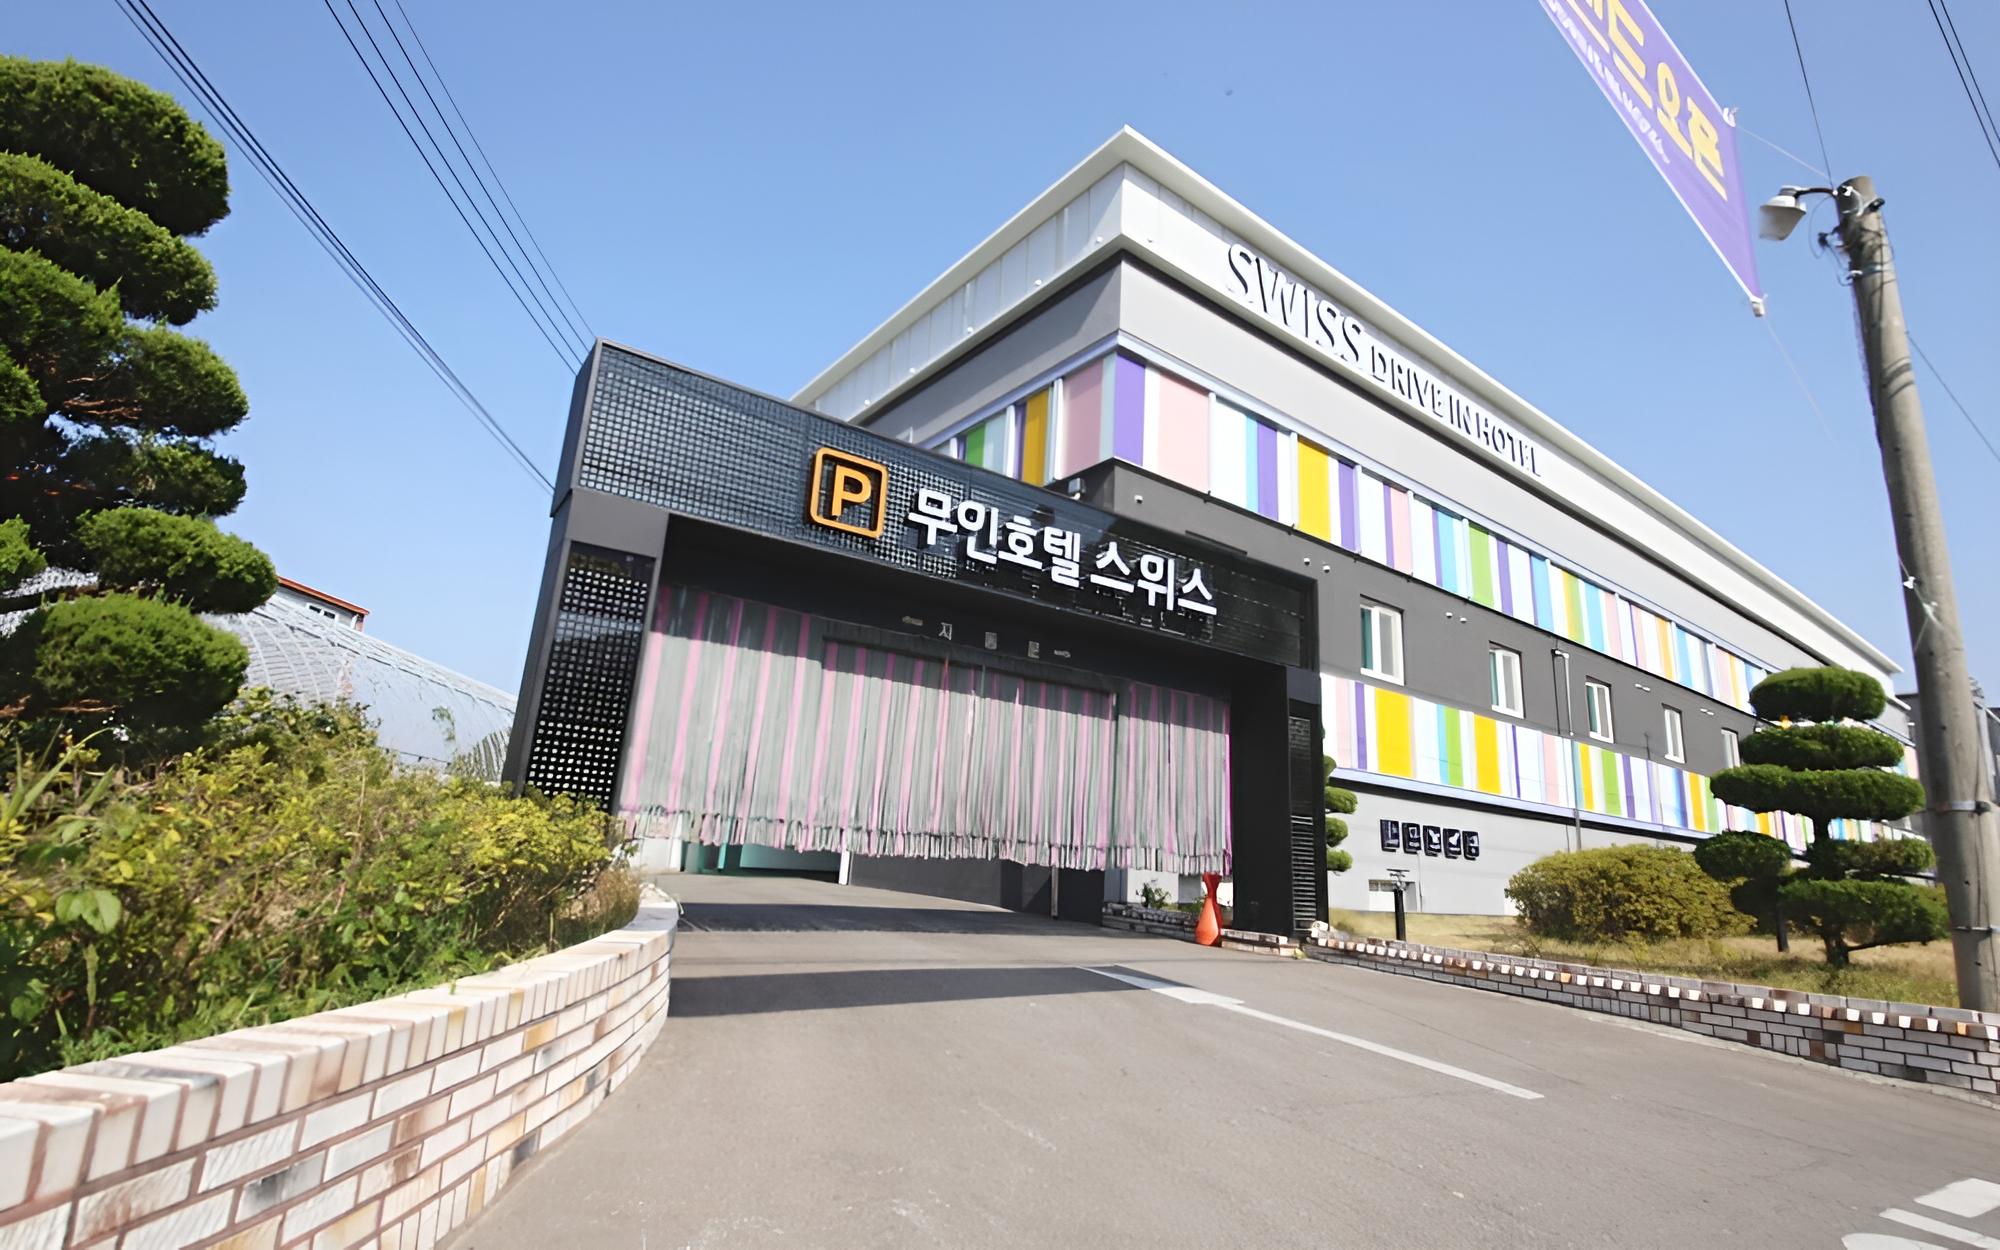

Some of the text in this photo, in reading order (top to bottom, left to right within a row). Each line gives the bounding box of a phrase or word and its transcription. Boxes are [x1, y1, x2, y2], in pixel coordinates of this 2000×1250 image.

[1226, 243, 1541, 478] SWISS DRIVE IN HOTEL
[830, 464, 872, 519] P
[907, 488, 1217, 616] 무인호텔 스위스
